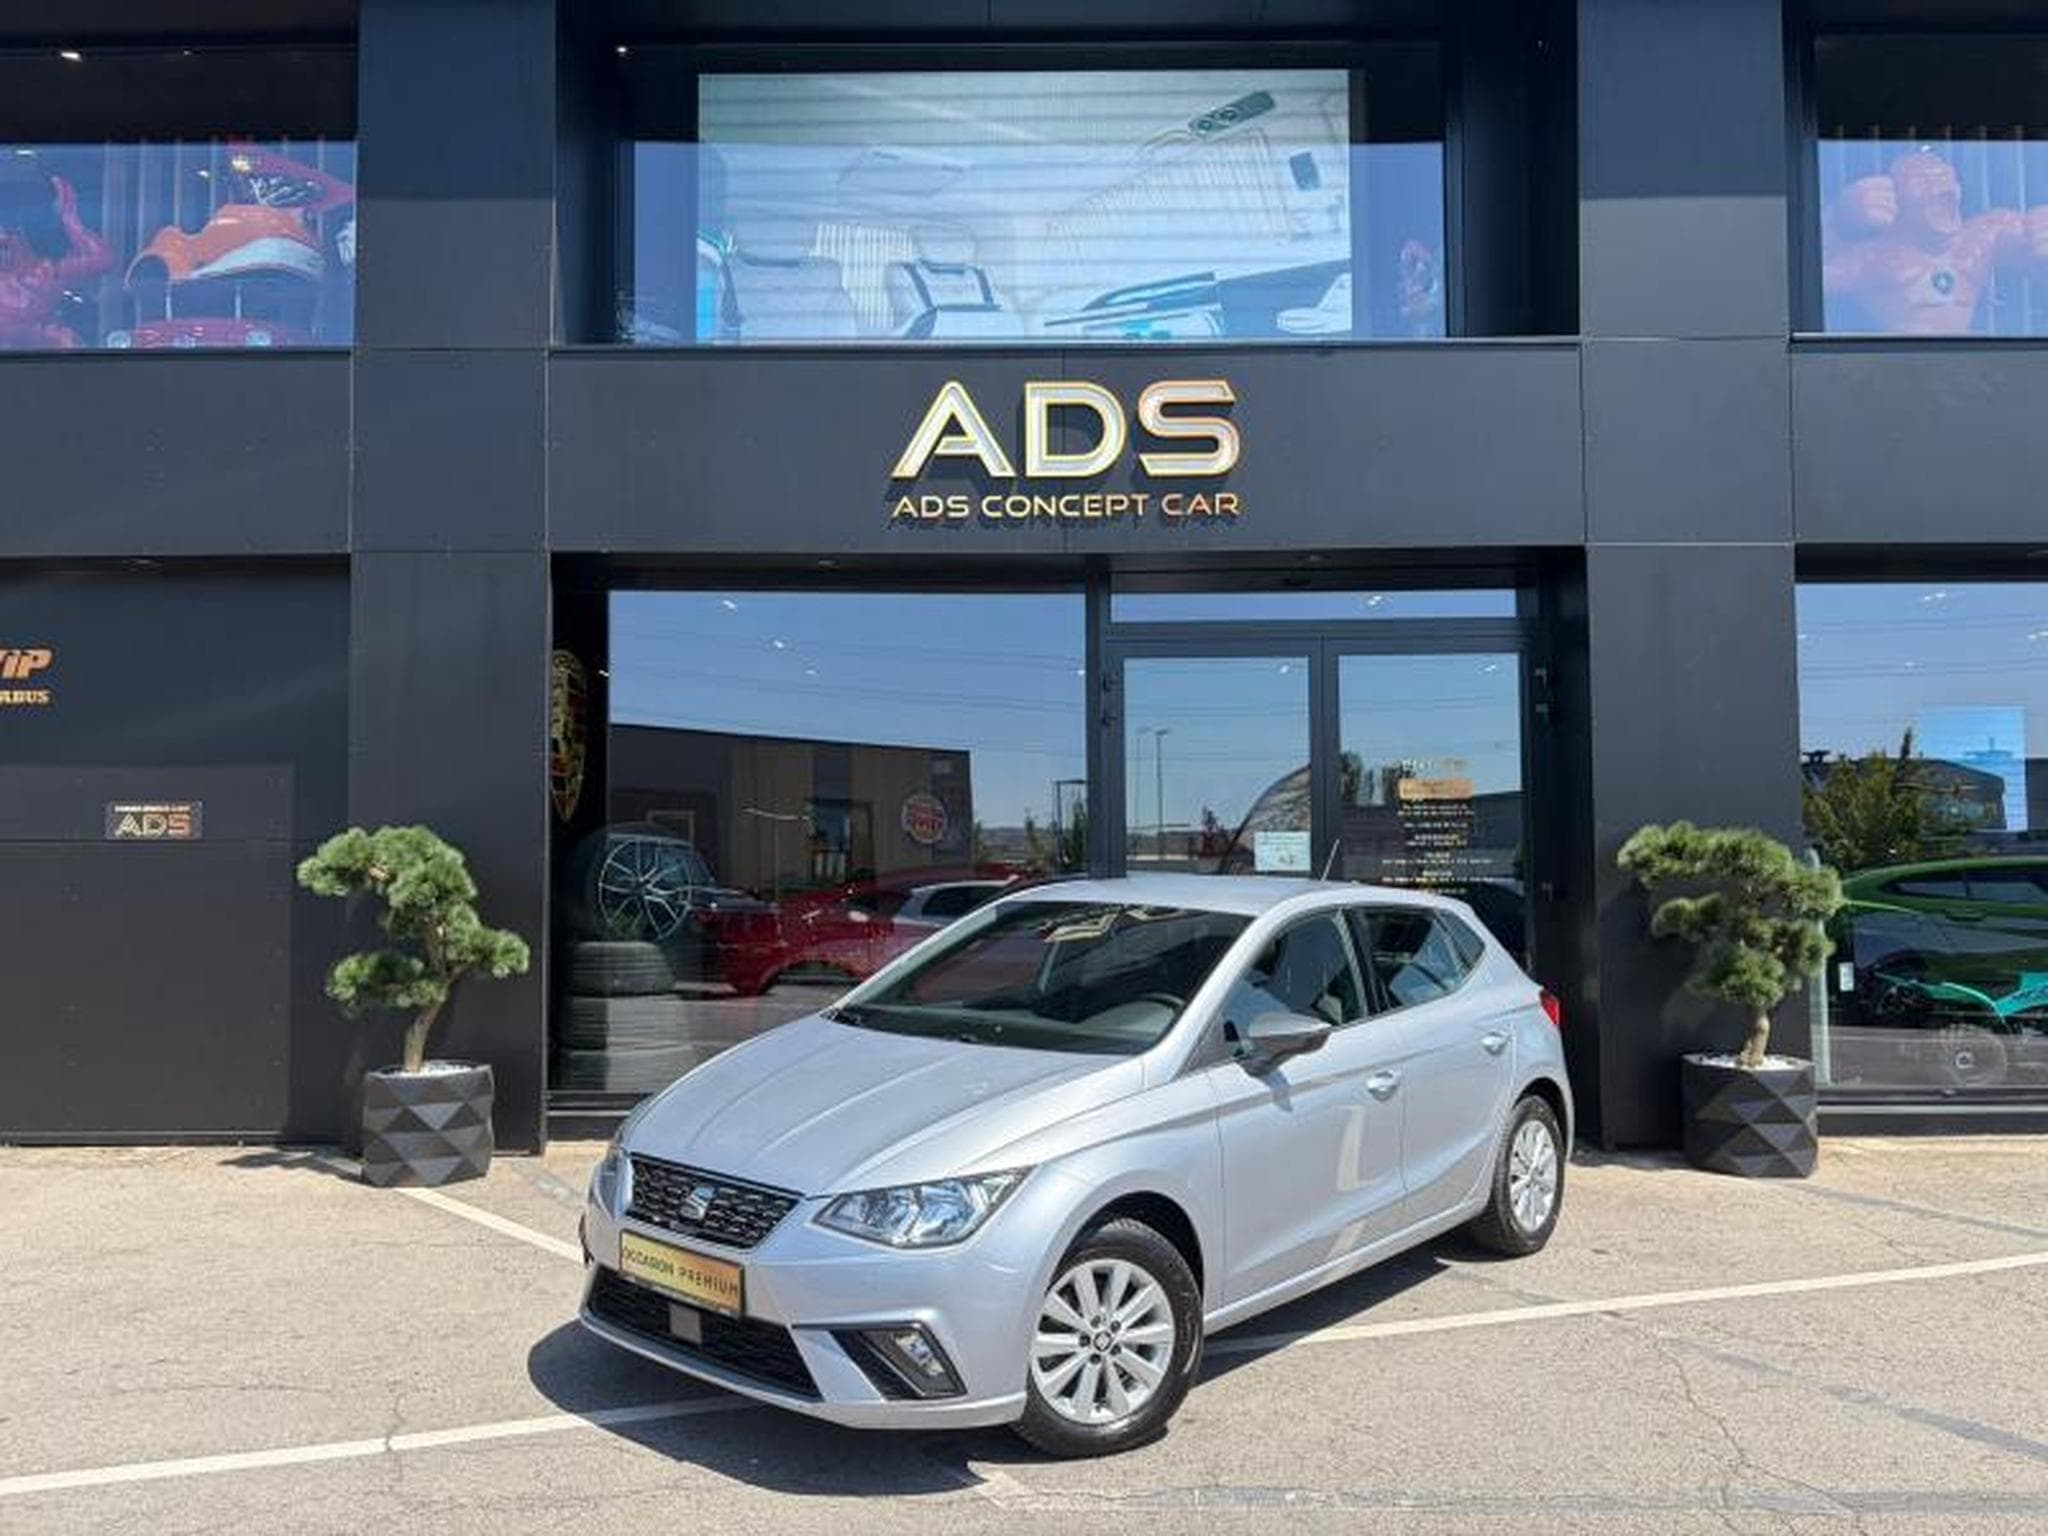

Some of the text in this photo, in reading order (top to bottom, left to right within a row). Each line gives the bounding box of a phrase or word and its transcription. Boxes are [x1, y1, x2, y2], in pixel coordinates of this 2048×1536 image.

[891, 380, 1241, 478] ADS
[892, 493, 1240, 518] ADS CONCEPT CAR
[114, 813, 192, 836] ADS
[678, 1266, 738, 1296] PREMIUM
